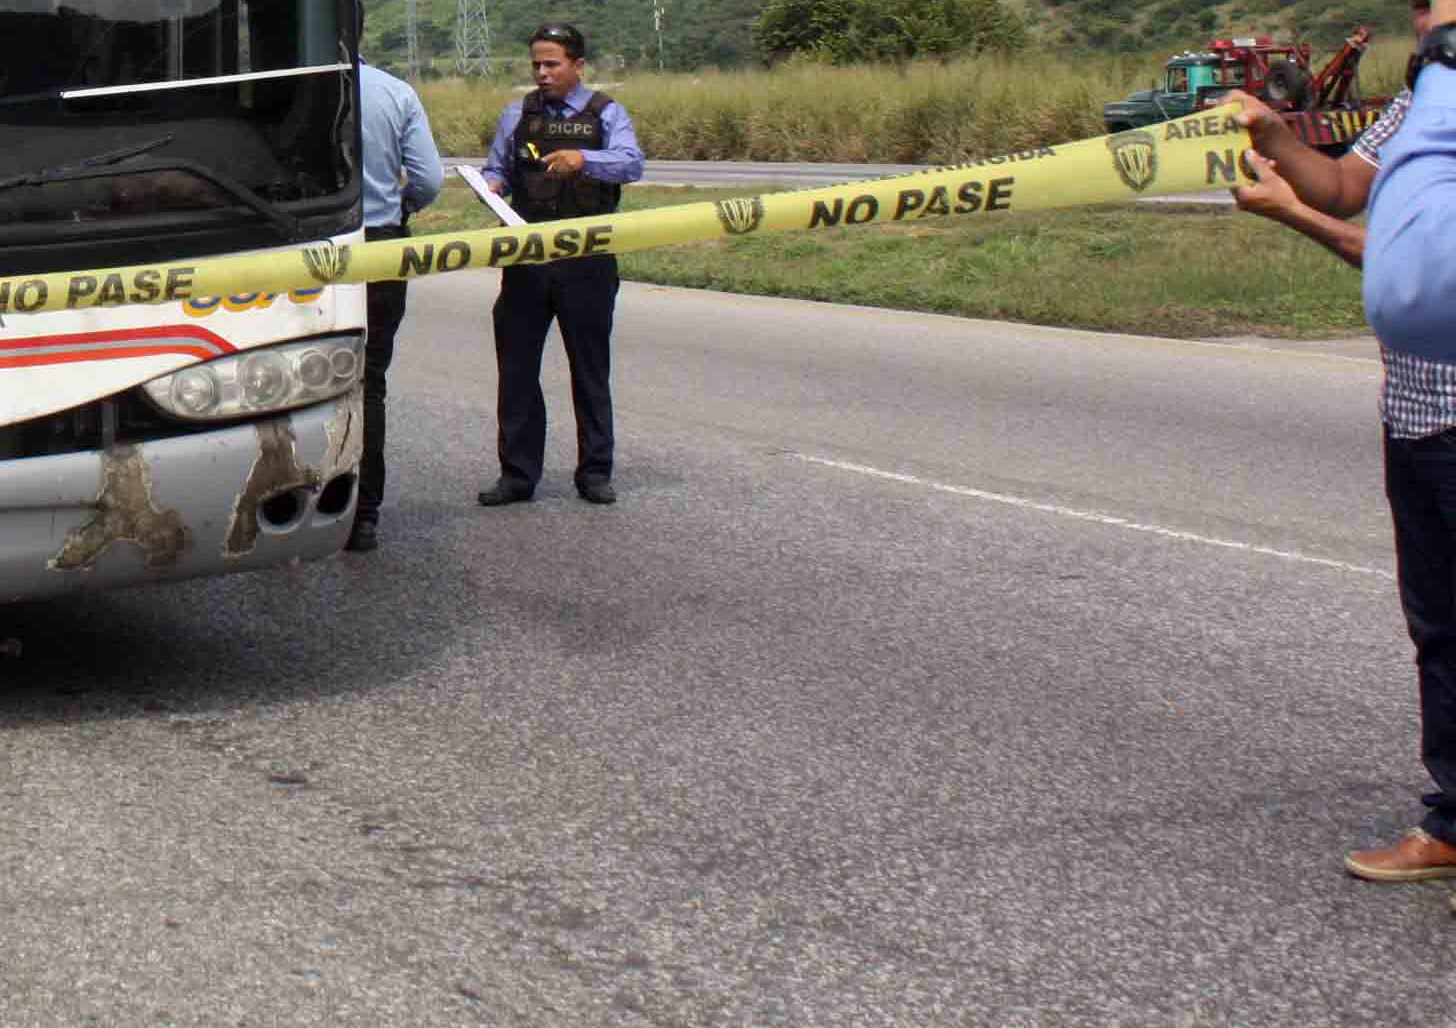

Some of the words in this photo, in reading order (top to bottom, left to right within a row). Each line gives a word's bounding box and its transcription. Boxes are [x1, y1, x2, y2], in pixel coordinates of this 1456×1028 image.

[1165, 115, 1241, 140] AREA
[808, 195, 879, 229] NO
[891, 177, 1015, 221] PASE
[398, 244, 472, 277] NO
[488, 225, 613, 267] PASE
[64, 267, 195, 308] PASE
